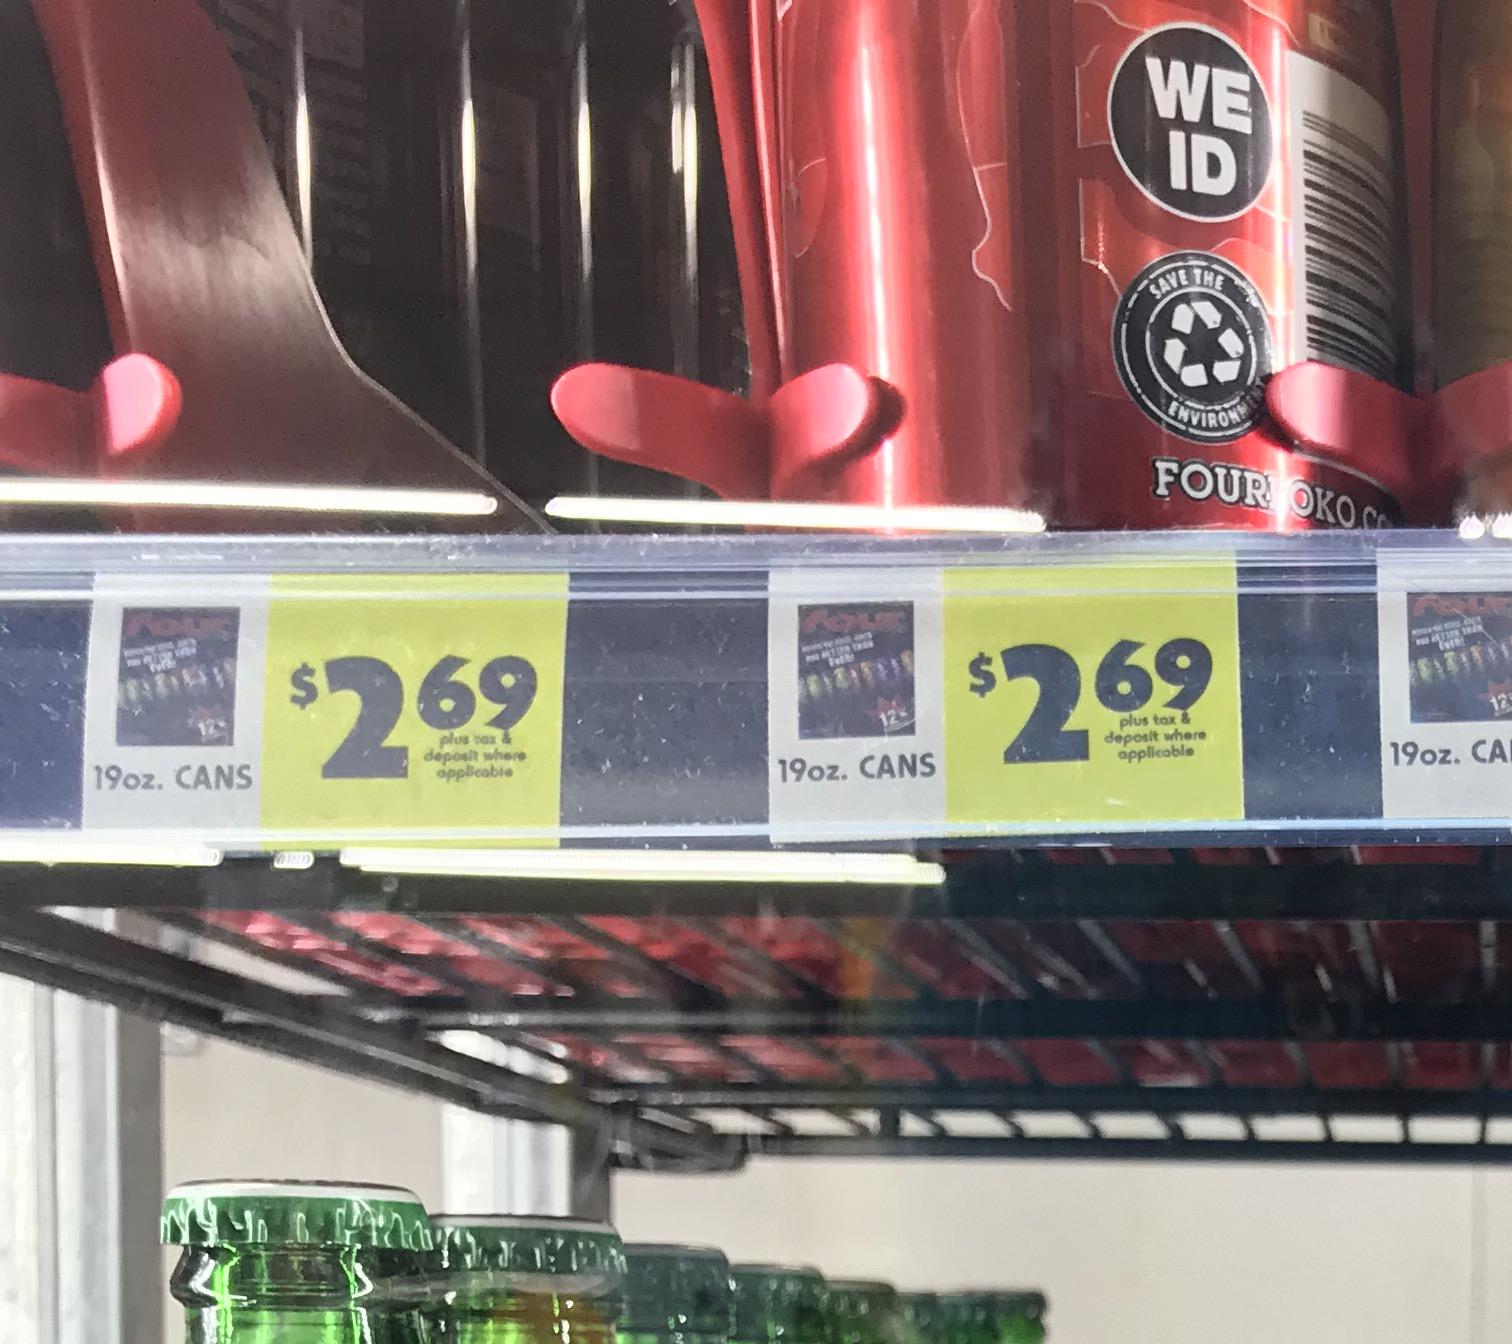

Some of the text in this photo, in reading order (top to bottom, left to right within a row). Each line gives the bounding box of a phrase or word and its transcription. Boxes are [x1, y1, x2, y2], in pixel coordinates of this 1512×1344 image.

[1145, 55, 1253, 135] WE
[1168, 130, 1237, 196] ID
[1150, 267, 1225, 300] SAVE THE
[1119, 712, 1178, 730] plus tax
[1104, 728, 1208, 747] deposit where
[1118, 744, 1195, 762] applicable
[1391, 742, 1460, 768] 19oz.
[94, 763, 254, 791] 19oz. CANS
[778, 752, 937, 784] 19oz. CANS
